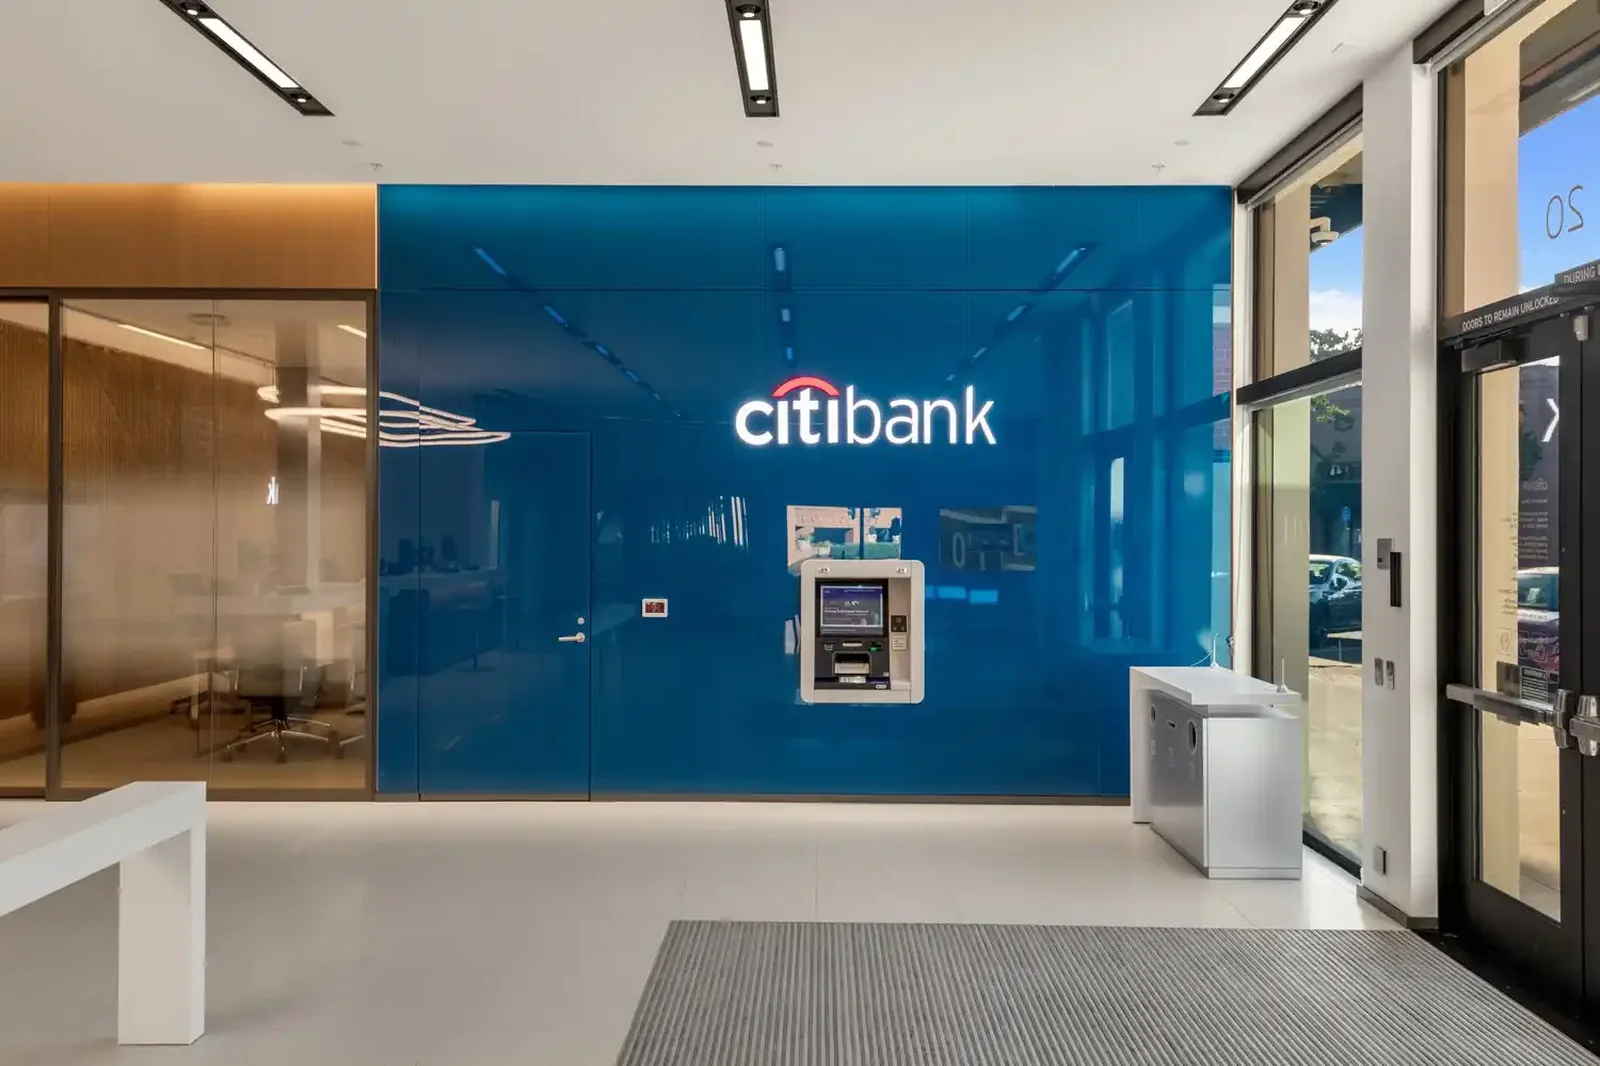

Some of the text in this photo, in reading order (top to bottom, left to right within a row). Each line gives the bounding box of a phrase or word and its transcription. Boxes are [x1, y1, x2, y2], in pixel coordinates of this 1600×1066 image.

[1563, 264, 1596, 285] DURING
[1462, 315, 1484, 332] DOORS
[1484, 313, 1493, 326] TO
[1493, 305, 1519, 323] REMAIN
[734, 383, 998, 446] citibank
